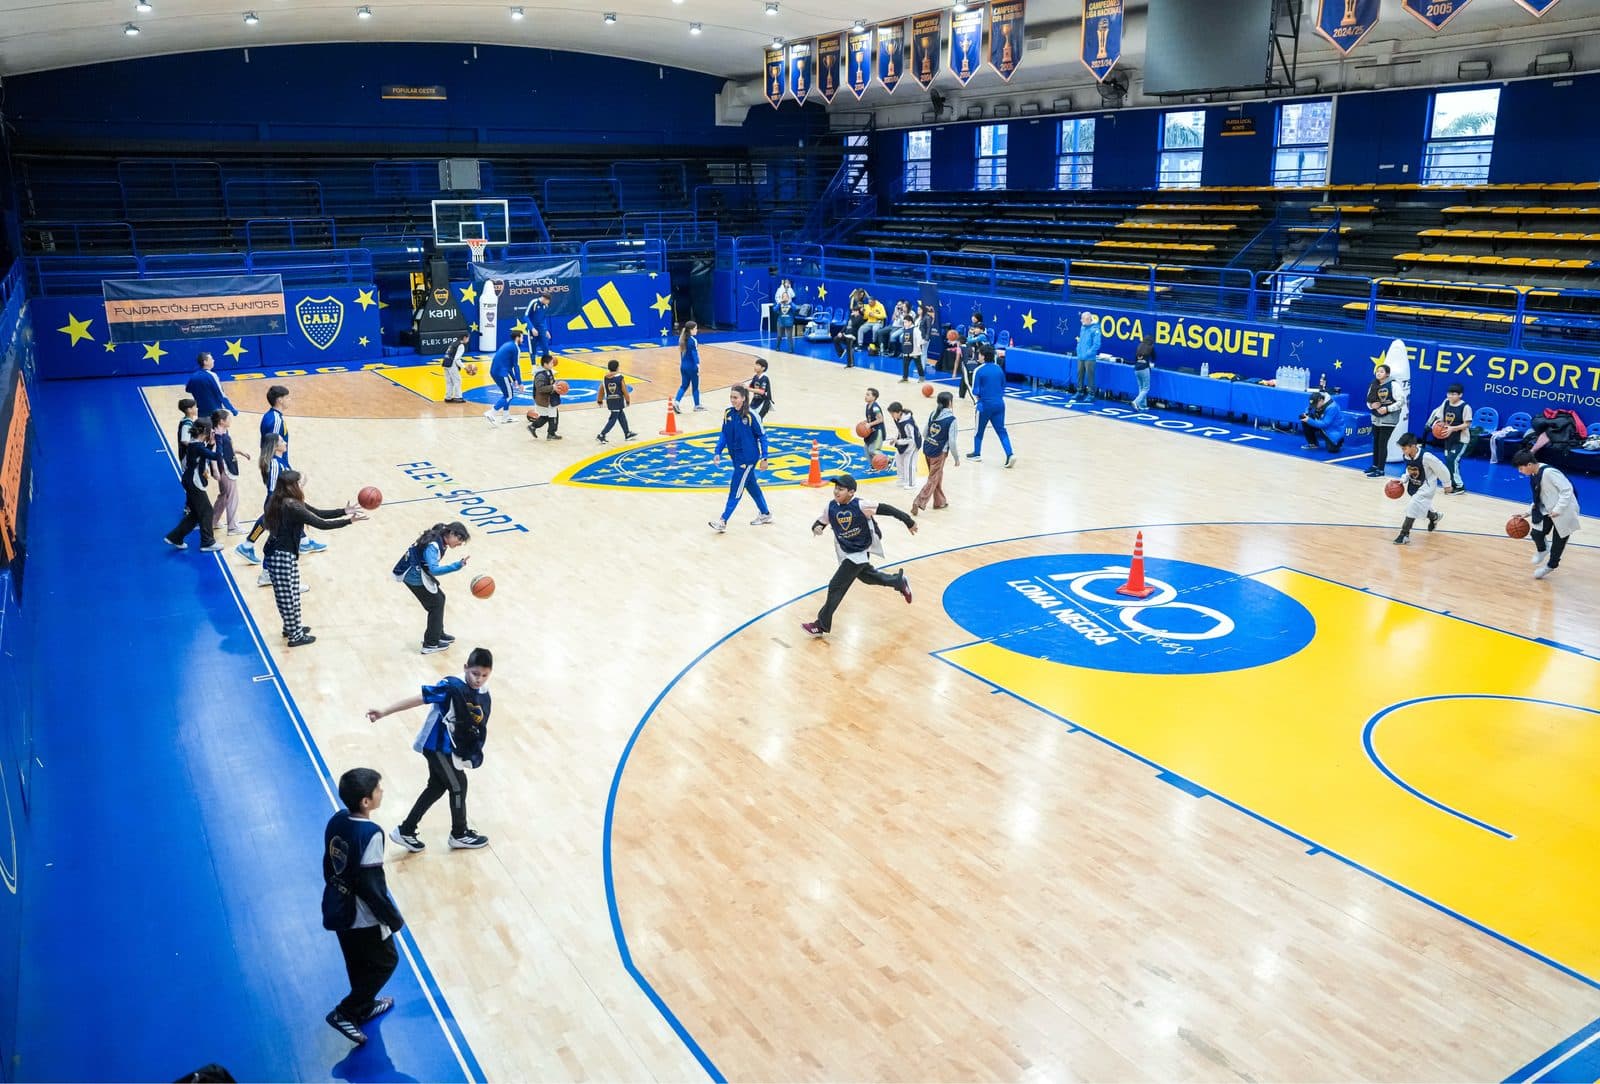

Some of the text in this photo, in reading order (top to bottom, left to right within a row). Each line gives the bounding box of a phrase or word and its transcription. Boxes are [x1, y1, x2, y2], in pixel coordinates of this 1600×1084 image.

[1426, 5, 1453, 17] 2005
[1332, 25, 1364, 38] 2024/25
[114, 300, 280, 315] FUNDACIÓN BOCA JUNIORS
[429, 309, 457, 319] kanji
[303, 313, 338, 324] CABJ
[422, 338, 441, 346] FLEX
[1155, 318, 1275, 358] BÁSQUET
[1487, 357, 1600, 391] SPORT
[1484, 383, 1600, 407] PISOS DEPORTIVOS
[1088, 407, 1272, 442] SPORT
[396, 461, 529, 534] FLEX SPORT
[1006, 579, 1119, 646] LOMA NEGRA
